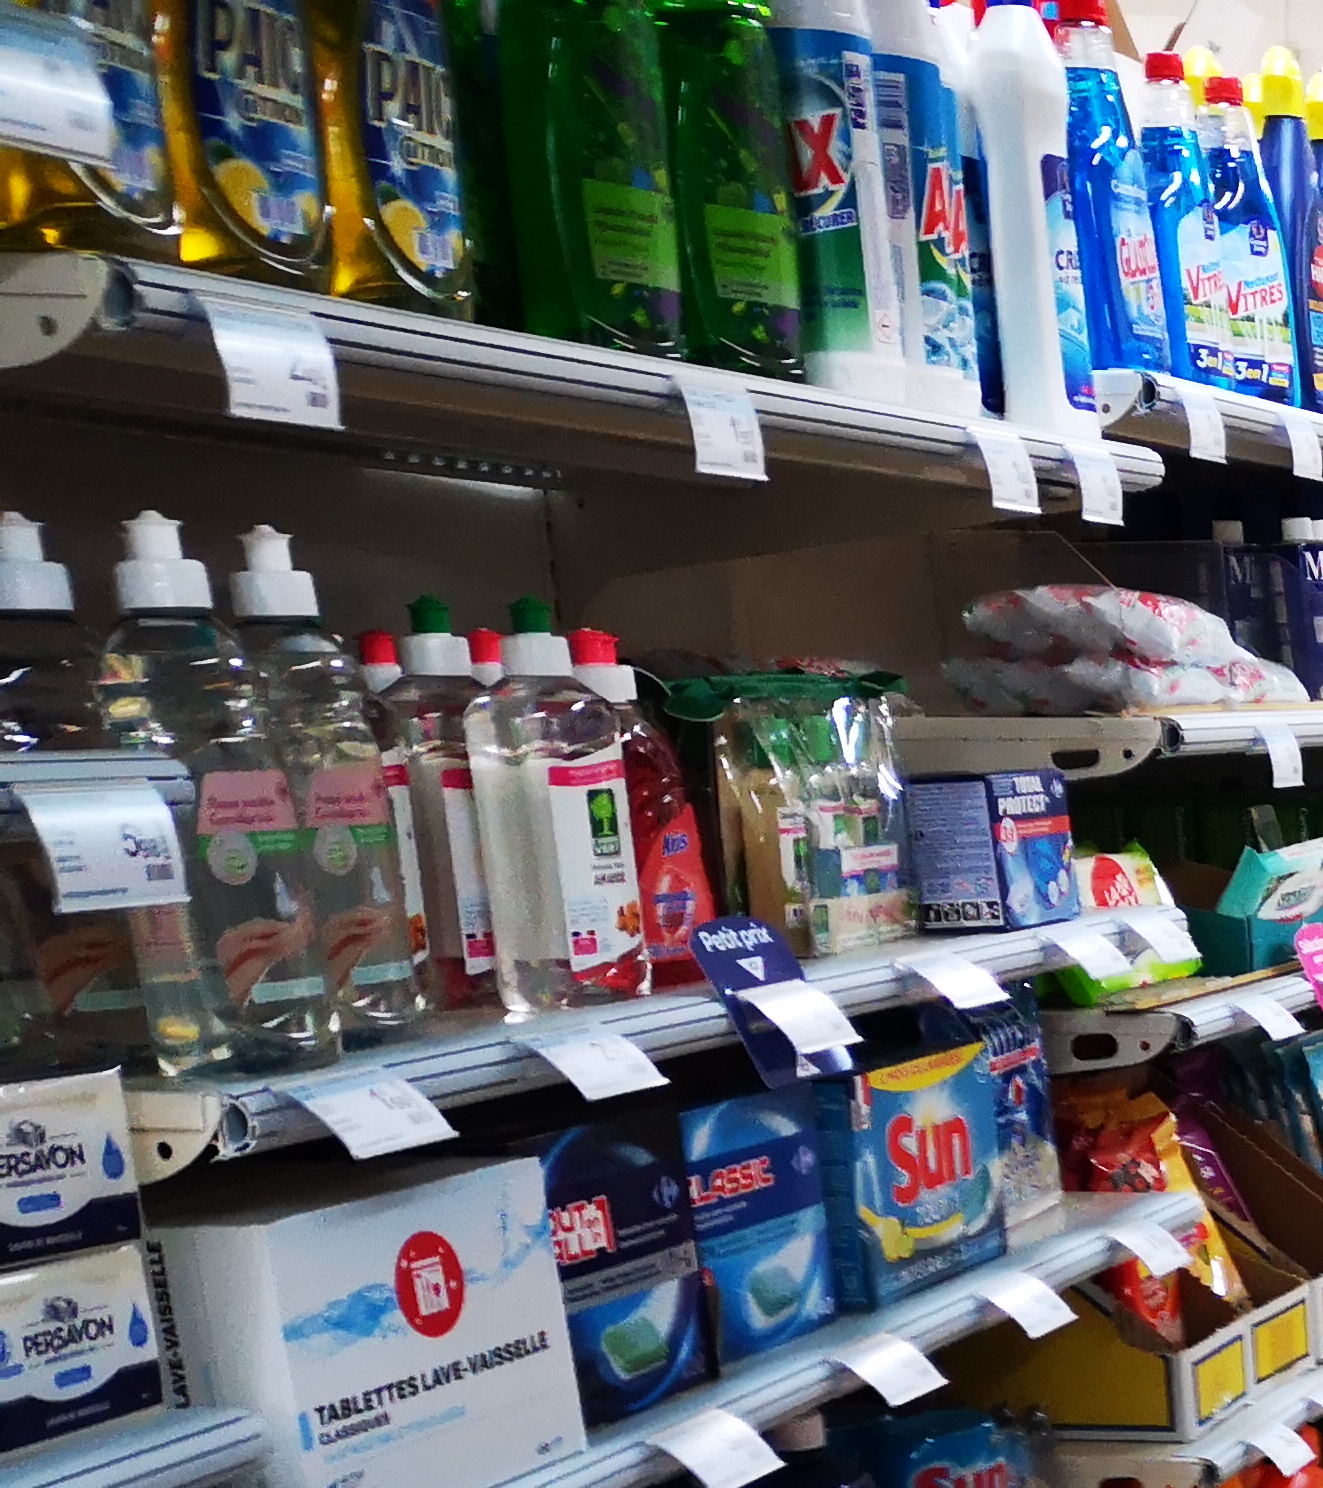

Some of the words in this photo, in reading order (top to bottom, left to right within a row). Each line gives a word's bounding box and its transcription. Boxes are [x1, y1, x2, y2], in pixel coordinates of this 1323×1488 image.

[1186, 264, 1222, 301] VITR
[698, 926, 743, 952] Petit
[738, 922, 774, 952] prix
[0, 1143, 86, 1178] ERSAVON
[688, 1155, 776, 1208] LASSIC
[885, 1113, 972, 1207] Sun
[23, 1314, 115, 1358] PERSAVON
[146, 1240, 191, 1409] LAVE-VAISSELLE
[314, 1375, 419, 1428] TABLETTES
[418, 1329, 550, 1394] LAVE-VAISSELLE
